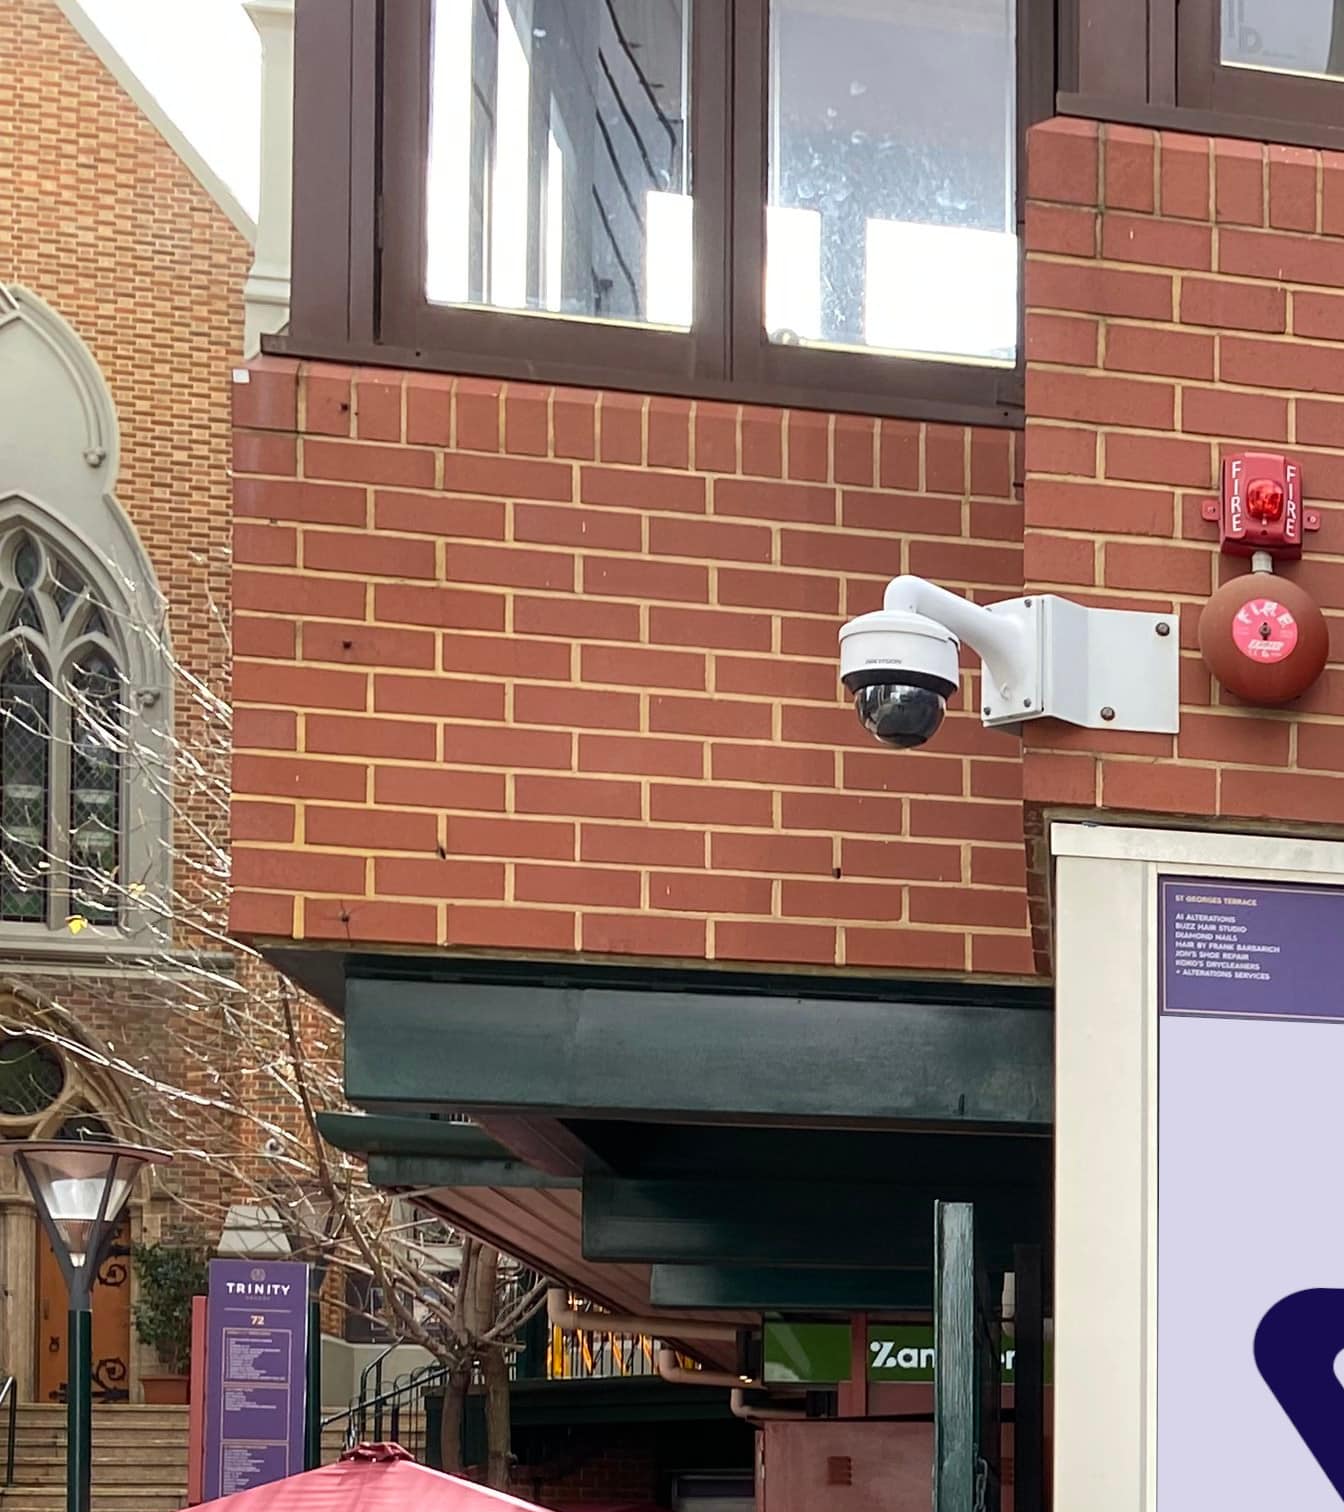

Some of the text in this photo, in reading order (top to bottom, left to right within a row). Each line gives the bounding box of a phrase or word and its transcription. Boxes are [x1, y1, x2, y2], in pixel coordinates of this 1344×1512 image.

[1231, 460, 1242, 532] FIRE
[1286, 465, 1297, 537] FIRE
[1237, 601, 1295, 626] FIRE
[1185, 895, 1222, 904] GEORGES
[1223, 897, 1257, 906] TERRACE
[1186, 913, 1236, 923] ALTERATIONS
[1175, 922, 1247, 933] BUZZ HAIR STUDIO
[1175, 932, 1238, 942] DIAMOND NAILS
[1208, 942, 1234, 950] FRANK
[1199, 951, 1220, 959] SHOE
[1206, 961, 1260, 970] DRYCLEANERS
[1182, 970, 1232, 978] ALTERATIONS
[1234, 972, 1270, 980] SERVICES
[226, 1282, 290, 1296] TRINITY
[250, 1314, 265, 1325] 72
